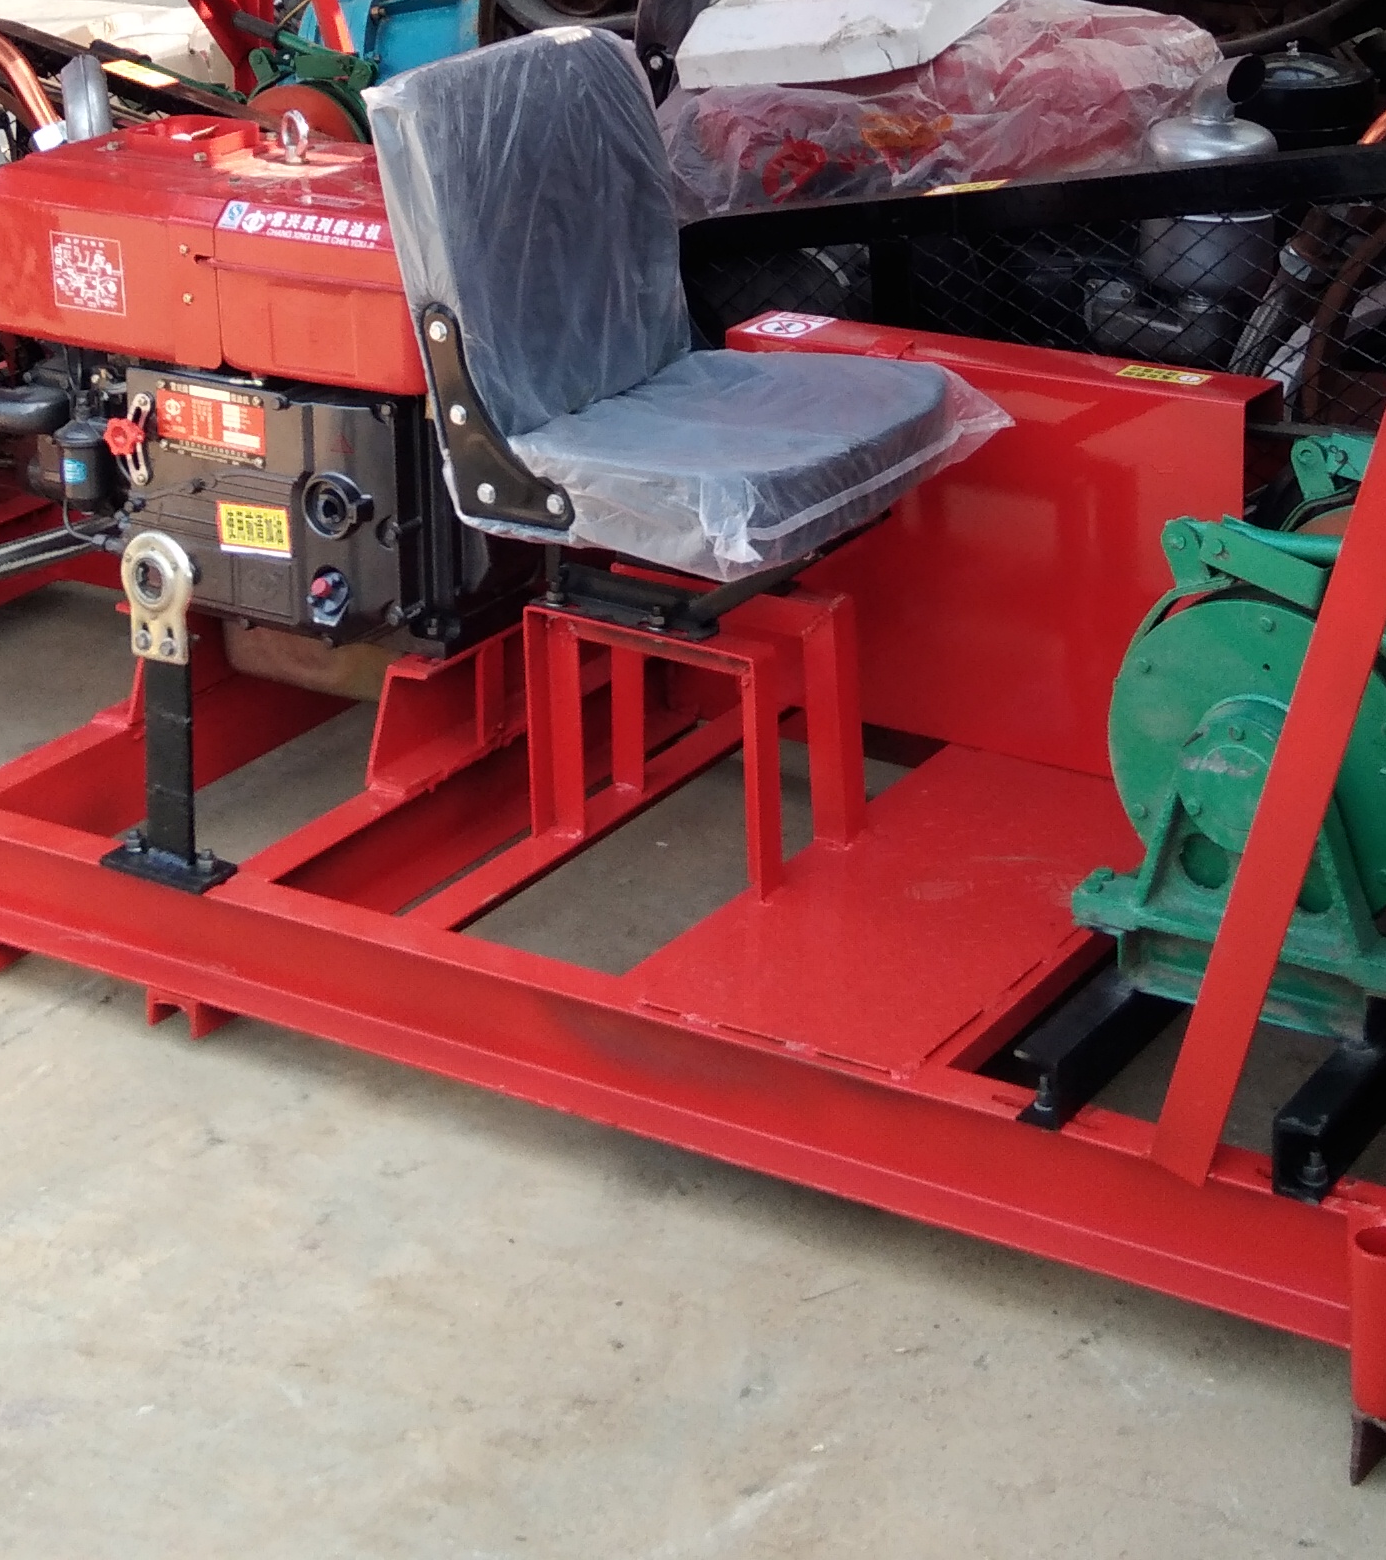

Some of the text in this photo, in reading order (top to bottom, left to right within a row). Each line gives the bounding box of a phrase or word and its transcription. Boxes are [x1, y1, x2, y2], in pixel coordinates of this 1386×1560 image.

[271, 211, 381, 240] 常兴系列柴油机
